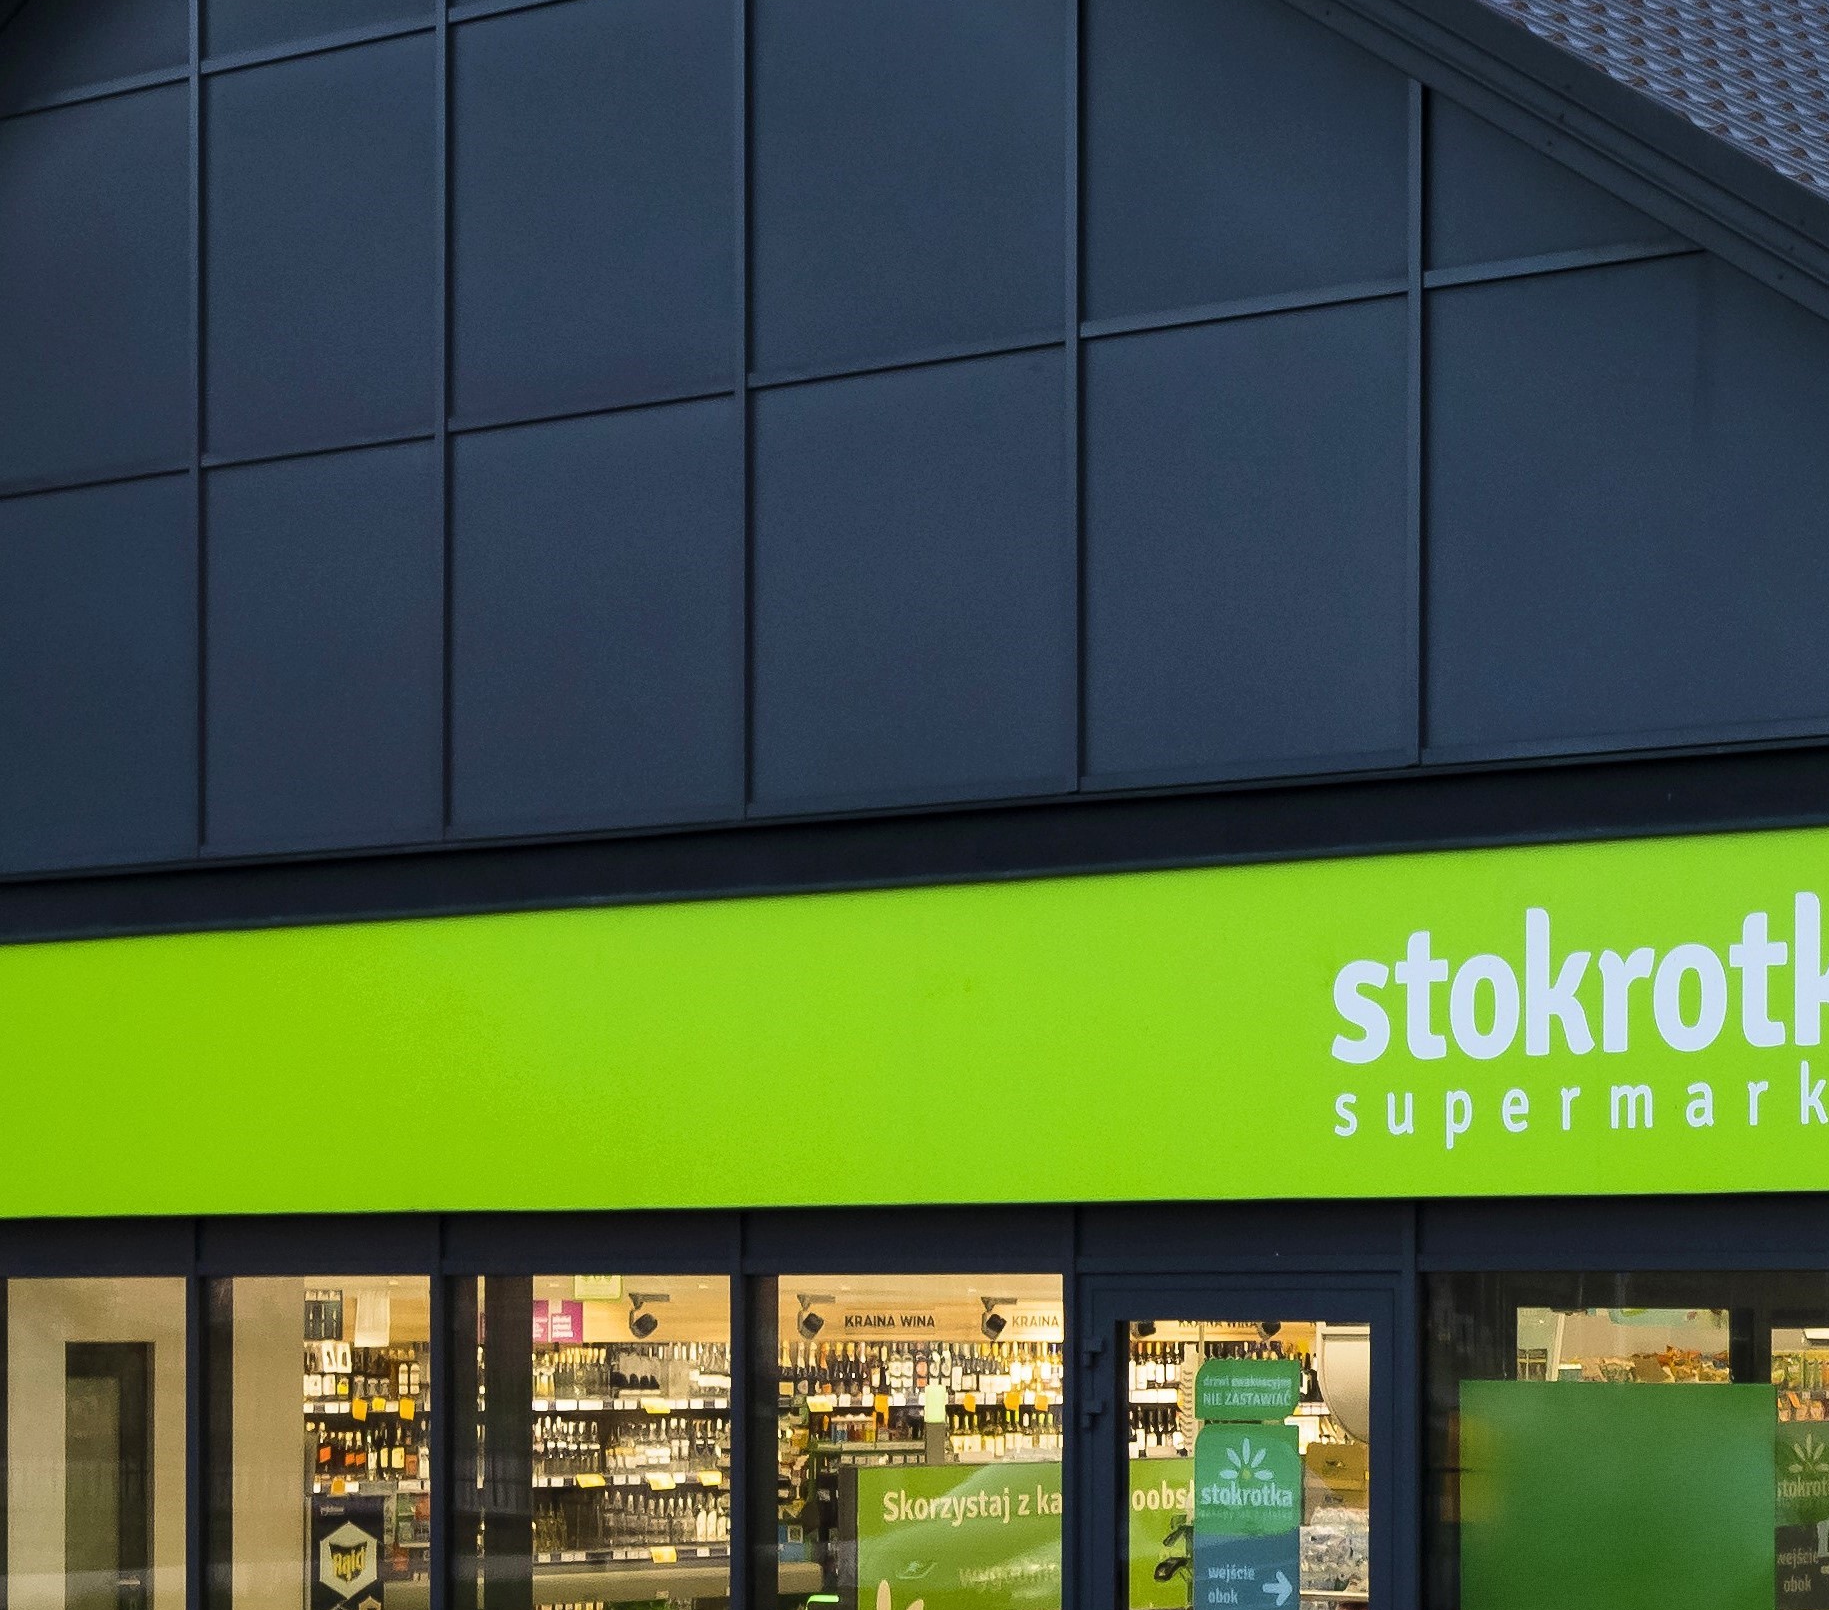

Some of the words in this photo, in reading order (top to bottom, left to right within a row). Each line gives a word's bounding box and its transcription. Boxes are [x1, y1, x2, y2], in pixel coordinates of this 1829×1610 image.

[845, 1314, 896, 1328] KRAINA
[900, 1314, 935, 1328] WINA
[1012, 1315, 1059, 1328] KRAINA
[1203, 1392, 1222, 1406] NIE
[1201, 1480, 1293, 1507] stokrotka
[883, 1487, 1010, 1527] Skorzystaj
[1017, 1494, 1030, 1516] z
[1208, 1563, 1256, 1583] wejście
[1784, 1574, 1812, 1592] obok
[1208, 1587, 1238, 1604] obok
